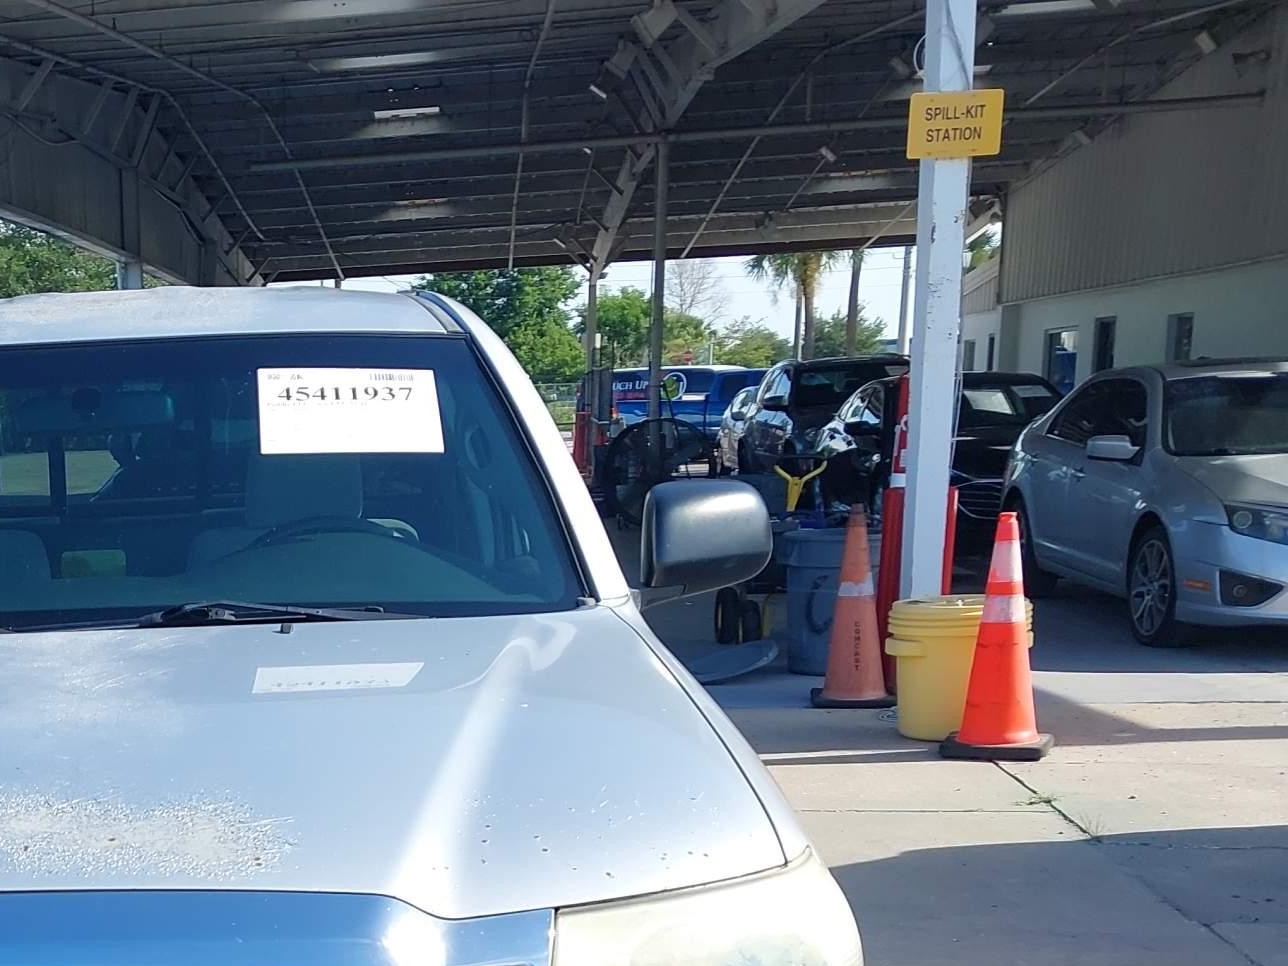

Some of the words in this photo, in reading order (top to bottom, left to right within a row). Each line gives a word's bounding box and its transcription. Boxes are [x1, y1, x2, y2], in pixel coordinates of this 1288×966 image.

[924, 104, 986, 121] SPILL-KIT
[926, 126, 982, 142] STATION
[277, 386, 413, 402] 45411937
